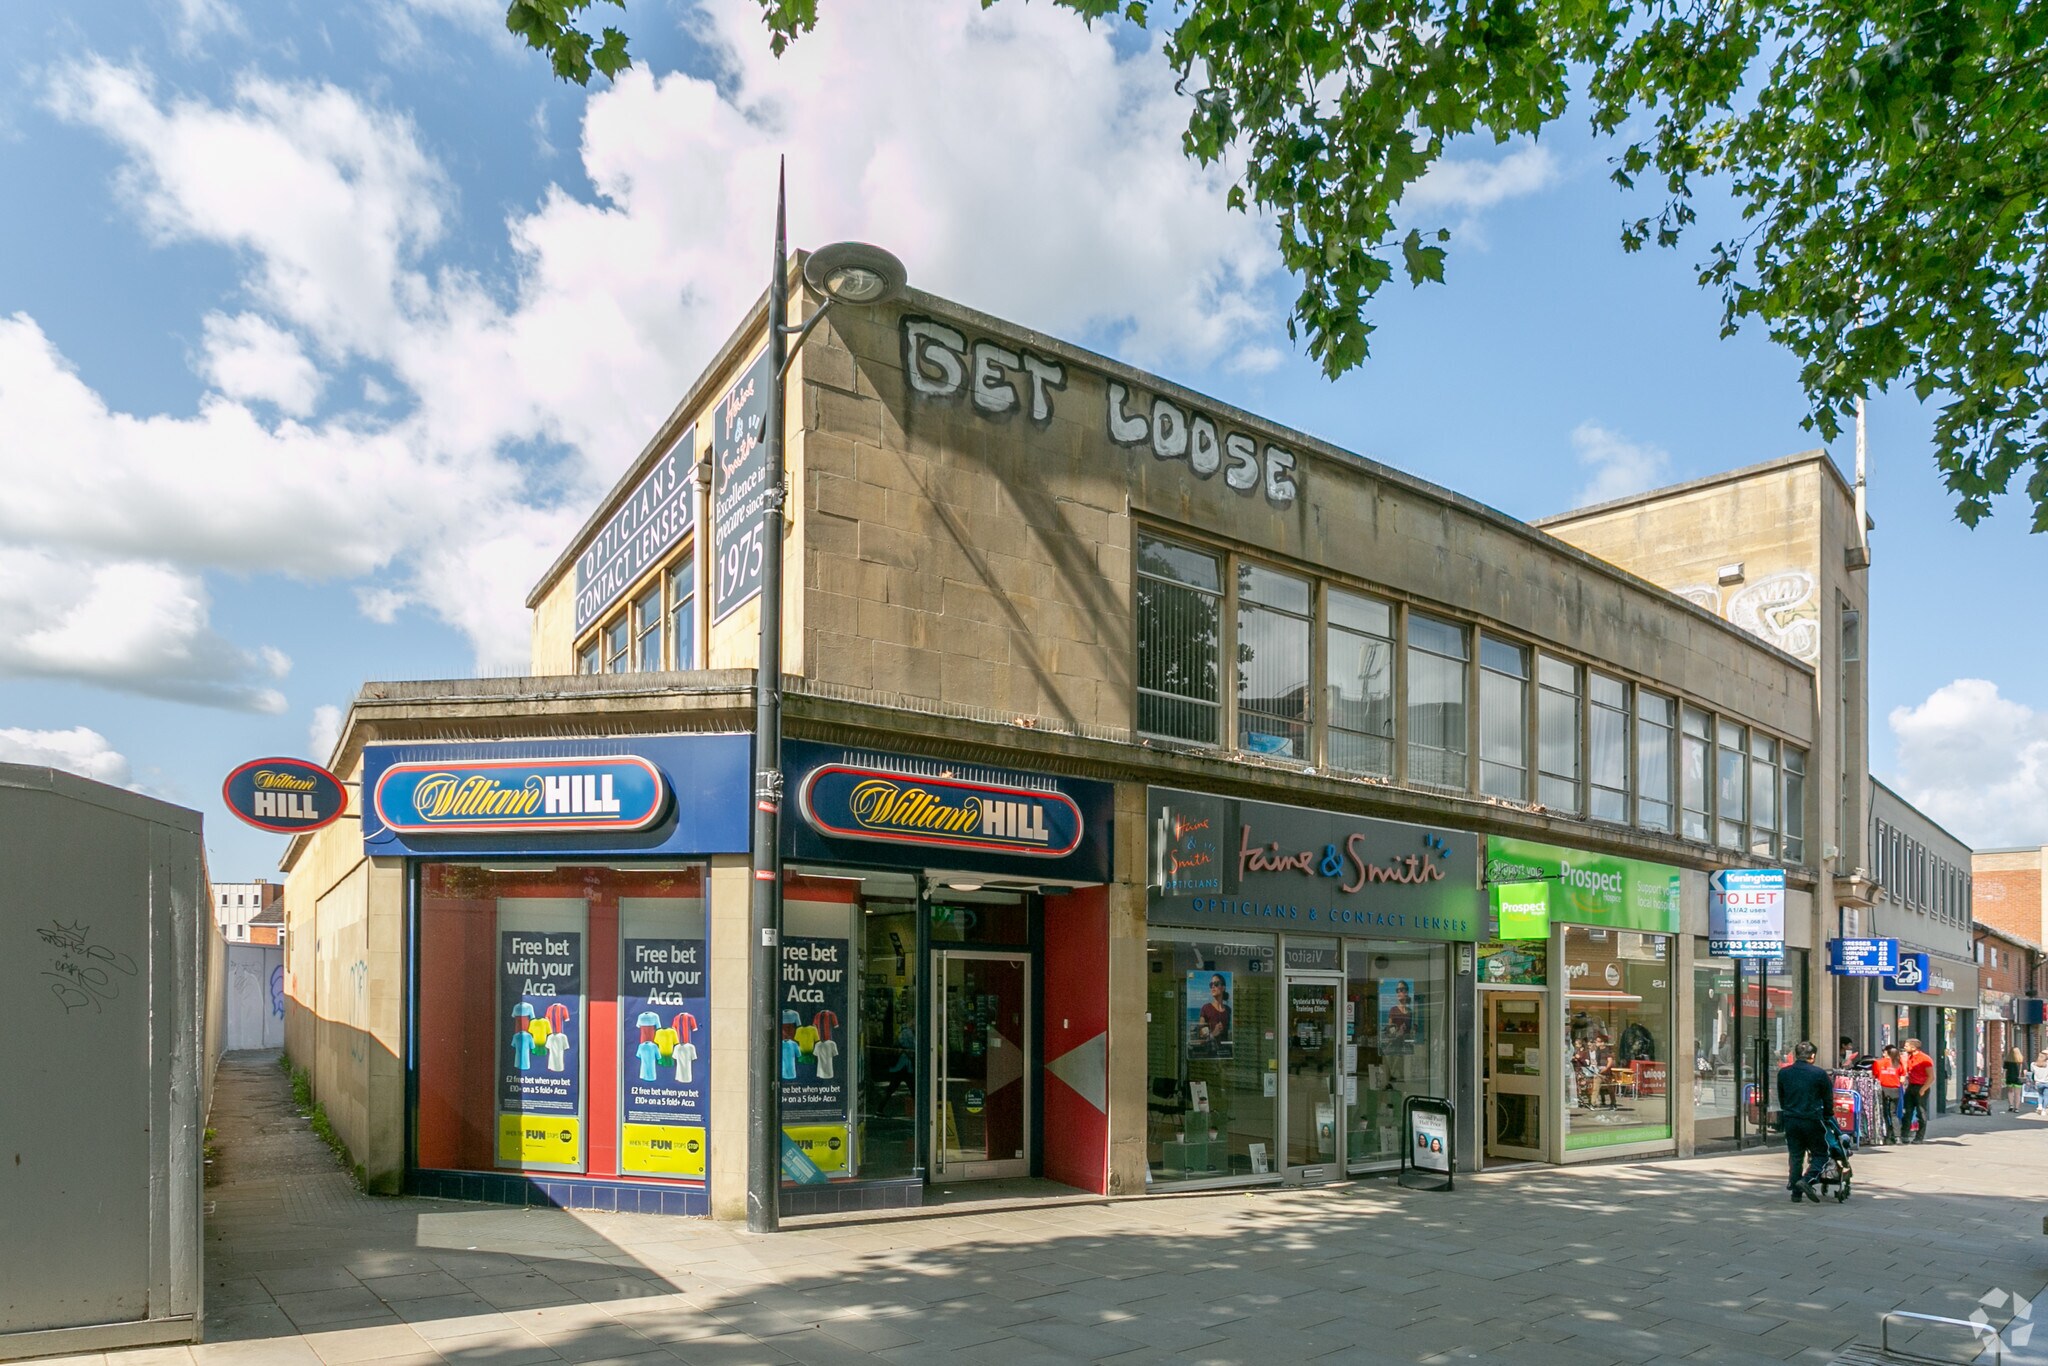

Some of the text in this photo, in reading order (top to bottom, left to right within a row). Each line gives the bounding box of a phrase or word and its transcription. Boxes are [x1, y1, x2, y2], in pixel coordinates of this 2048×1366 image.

[725, 377, 754, 440] Haine
[900, 314, 1298, 509] GET LOOSE
[720, 434, 757, 494] Smith
[716, 466, 766, 524] Excellence in
[586, 456, 676, 580] OPTICIANS
[716, 493, 764, 550] eyecare since
[577, 492, 687, 625] CONTACT LENSES
[718, 520, 763, 605] 1975
[253, 770, 317, 790] William
[254, 792, 318, 819] HILL
[413, 773, 620, 819] William HILL
[850, 780, 1048, 841] William HILL
[1187, 836, 1196, 850] &
[1169, 850, 1212, 875] Smith
[1320, 843, 1344, 878] &
[1342, 833, 1446, 894] Smith
[1166, 879, 1218, 889] OPTICIANS
[1561, 861, 1622, 896] Prospect
[1637, 881, 1661, 895] Support
[1726, 874, 1782, 884] Keningtons
[1502, 902, 1545, 914] Prospect
[1638, 896, 1652, 908] local
[1716, 893, 1776, 904] TO LET
[1193, 898, 1467, 932] OPTICIANS & CONTACT LENSES
[512, 937, 569, 956] Free bet
[636, 945, 697, 964] Free bet
[783, 943, 837, 962] ree bet
[1711, 941, 1782, 949] 01793 423351
[507, 958, 574, 980] with your
[631, 966, 702, 988] with your
[783, 963, 843, 986] ith your
[522, 978, 557, 996] Acca
[647, 987, 684, 1006] Acca
[787, 985, 824, 1003] Acca
[1296, 1005, 1313, 1013] Training
[525, 1076, 534, 1084] bet
[534, 1077, 549, 1085] when
[561, 1078, 570, 1086] bet
[791, 1086, 801, 1094] bet
[802, 1085, 818, 1093] when
[819, 1086, 829, 1094] you
[631, 1087, 638, 1095] £2
[639, 1087, 651, 1095] free
[651, 1088, 660, 1096] bet
[660, 1088, 677, 1096] when
[666, 1098, 680, 1106] fold+
[681, 1099, 695, 1107] Acca
[526, 1129, 546, 1140] FUN
[651, 1140, 672, 1150] FUN
